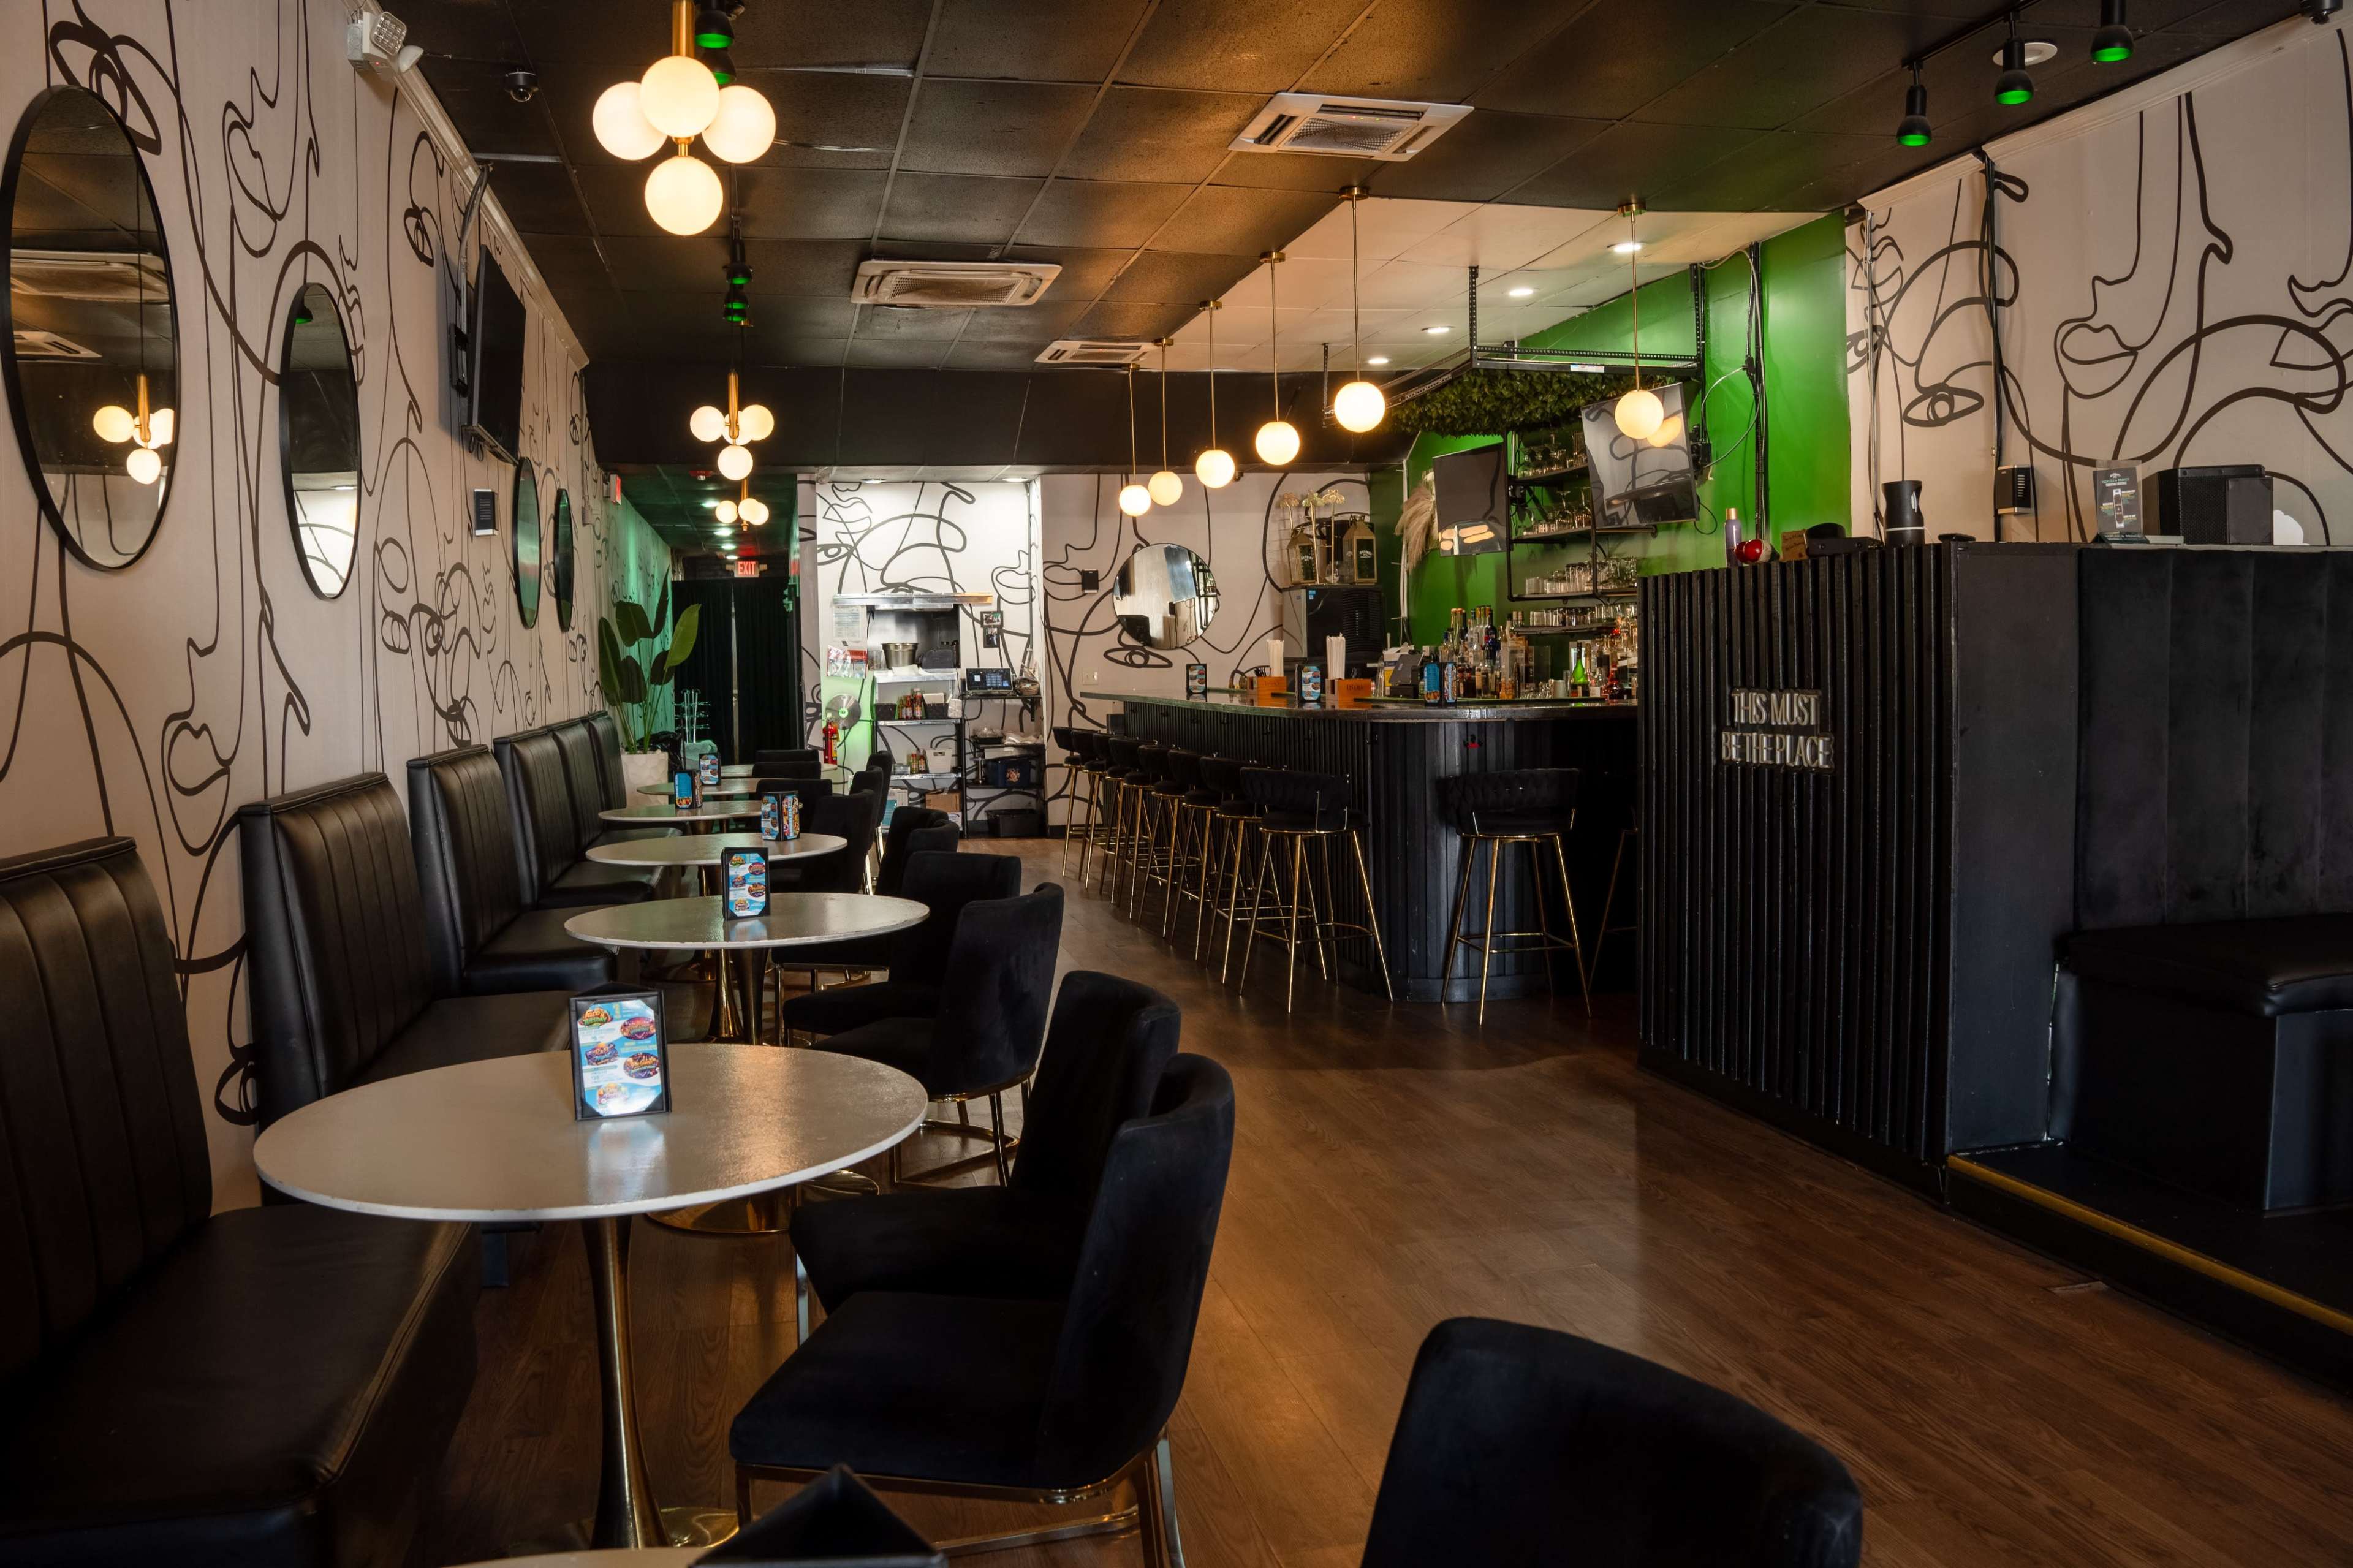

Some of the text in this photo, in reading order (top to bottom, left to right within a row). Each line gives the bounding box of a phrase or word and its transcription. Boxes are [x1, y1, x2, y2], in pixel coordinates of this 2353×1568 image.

[738, 561, 756, 575] EXIT
[1732, 692, 1821, 725] THIS MUST
[1722, 731, 1831, 768] BE THE PLACE
